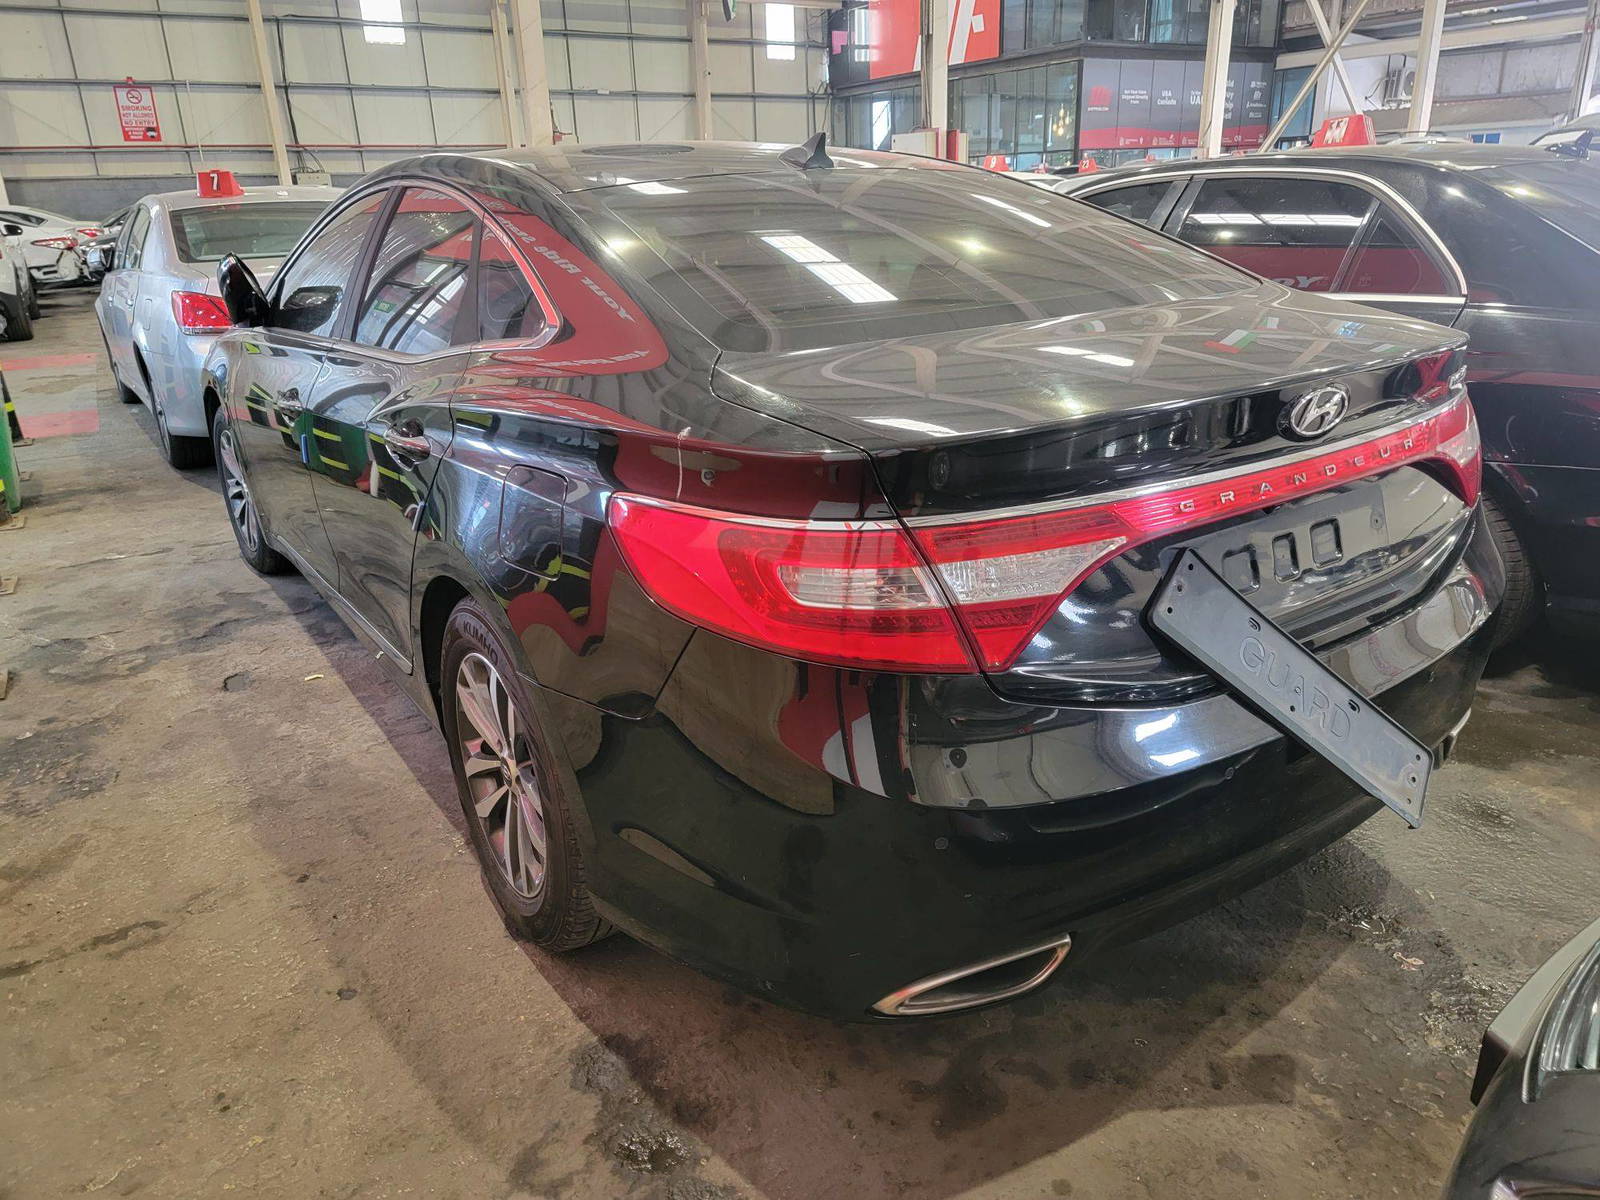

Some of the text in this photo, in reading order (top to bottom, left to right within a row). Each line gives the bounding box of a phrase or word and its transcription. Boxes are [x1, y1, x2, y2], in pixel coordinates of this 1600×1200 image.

[210, 173, 218, 190] 7
[1179, 438, 1414, 512] GRANDEUR
[462, 620, 499, 666] KUMHO
[1240, 636, 1351, 738] GUARD
